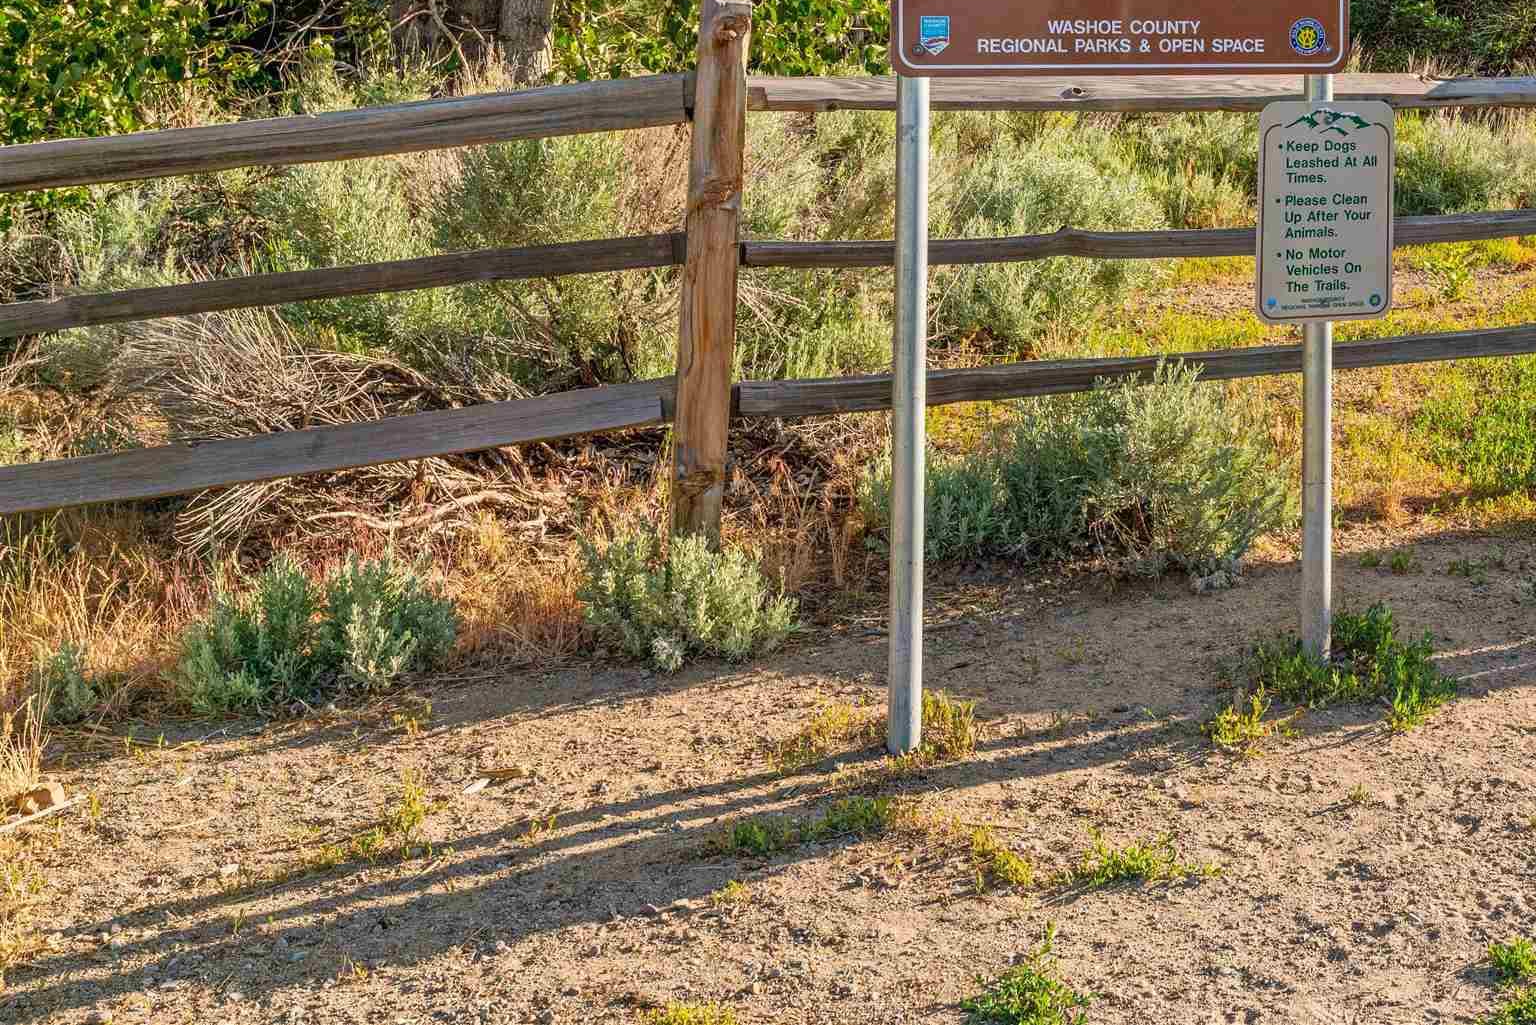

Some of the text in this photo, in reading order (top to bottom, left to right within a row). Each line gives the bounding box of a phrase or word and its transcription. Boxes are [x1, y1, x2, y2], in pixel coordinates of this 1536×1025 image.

[1047, 19, 1201, 35] WASHOE COUNTY
[976, 38, 1265, 54] REGIONAL PARKS & OPEN SPACE
[1286, 139, 1357, 154] Keep Dogs
[1286, 155, 1377, 169] Leashed At All
[1286, 172, 1328, 184] Times.
[1285, 193, 1368, 207] Please Clean
[1284, 209, 1371, 224] Up After Your
[1284, 226, 1338, 240] Animals.
[1285, 247, 1346, 261] No Motor
[1286, 262, 1362, 277] Vehicles On
[1285, 279, 1351, 293] The Trails.
